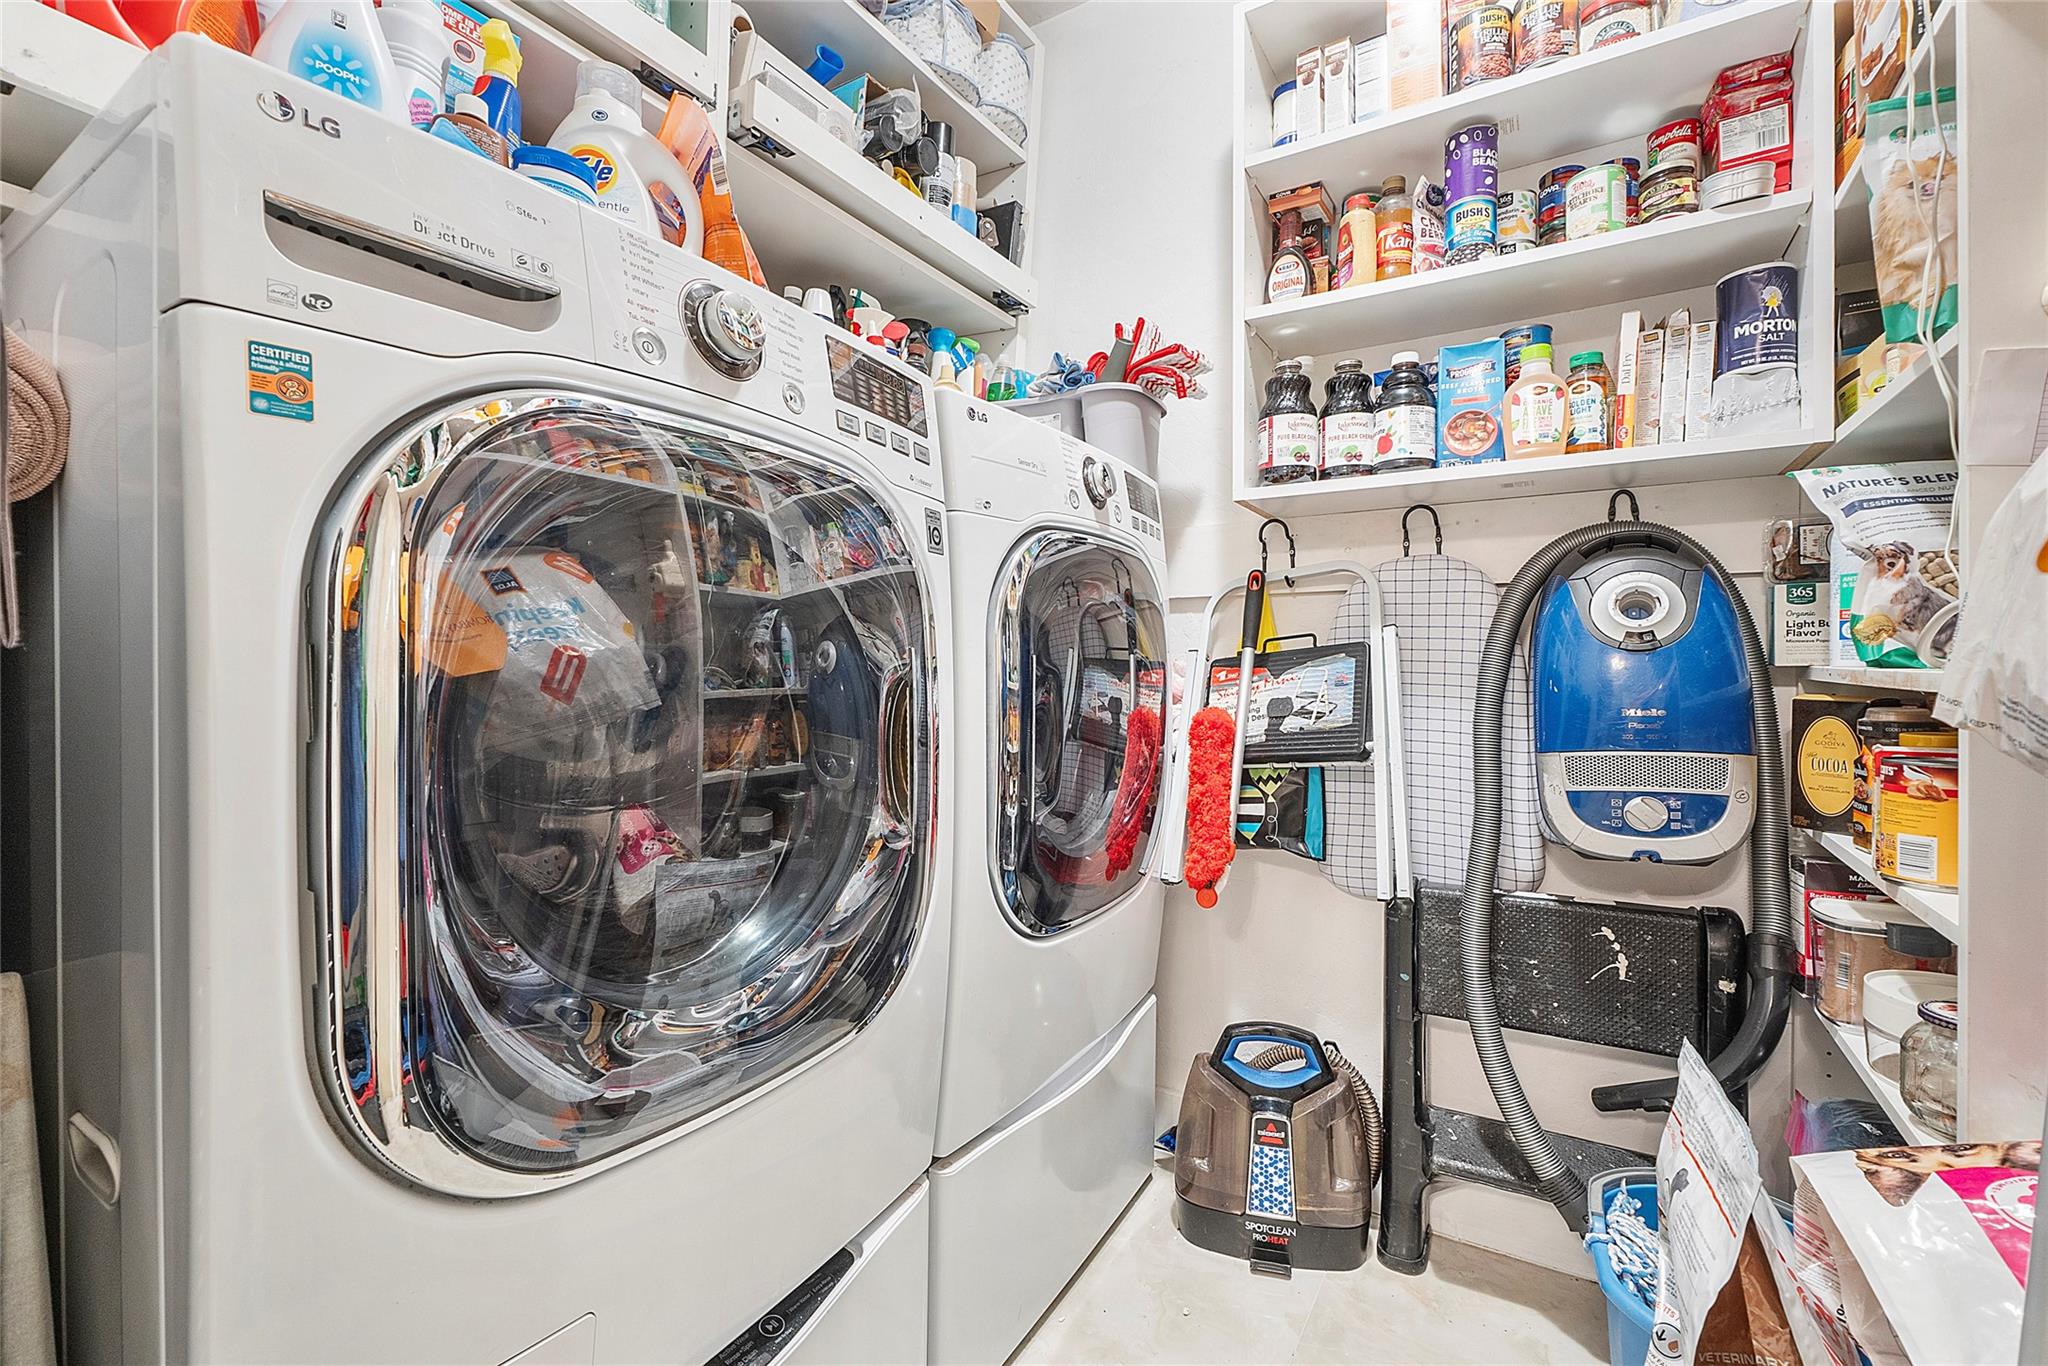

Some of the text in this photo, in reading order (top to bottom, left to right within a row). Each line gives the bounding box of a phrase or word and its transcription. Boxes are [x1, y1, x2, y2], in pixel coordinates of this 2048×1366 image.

[315, 60, 361, 84] POOPH
[301, 107, 341, 139] LG
[598, 199, 630, 214] entle
[460, 236, 495, 258] Drive
[1272, 277, 1304, 292] ORIGINAL
[1733, 318, 1797, 340] MORTON
[1758, 332, 1785, 343] SALT
[250, 344, 311, 365] CERTIFIED
[1620, 369, 1632, 385] Dal
[977, 411, 989, 423] LG
[1822, 476, 1911, 499] NATURE'S
[1862, 496, 1917, 509] ESSENTIAL
[1788, 587, 1814, 598] 365
[1786, 609, 1816, 619] Organic
[1786, 619, 1814, 630] Light
[1786, 629, 1823, 637] Flavor
[1621, 708, 1668, 717] Miele
[1814, 740, 1847, 748] GODIVA
[1811, 757, 1849, 774] COCOA
[1245, 1221, 1297, 1237] SPOTCLEAN
[1252, 1232, 1289, 1245] PROHEAT
[1699, 1351, 1790, 1366] VETERINARY
